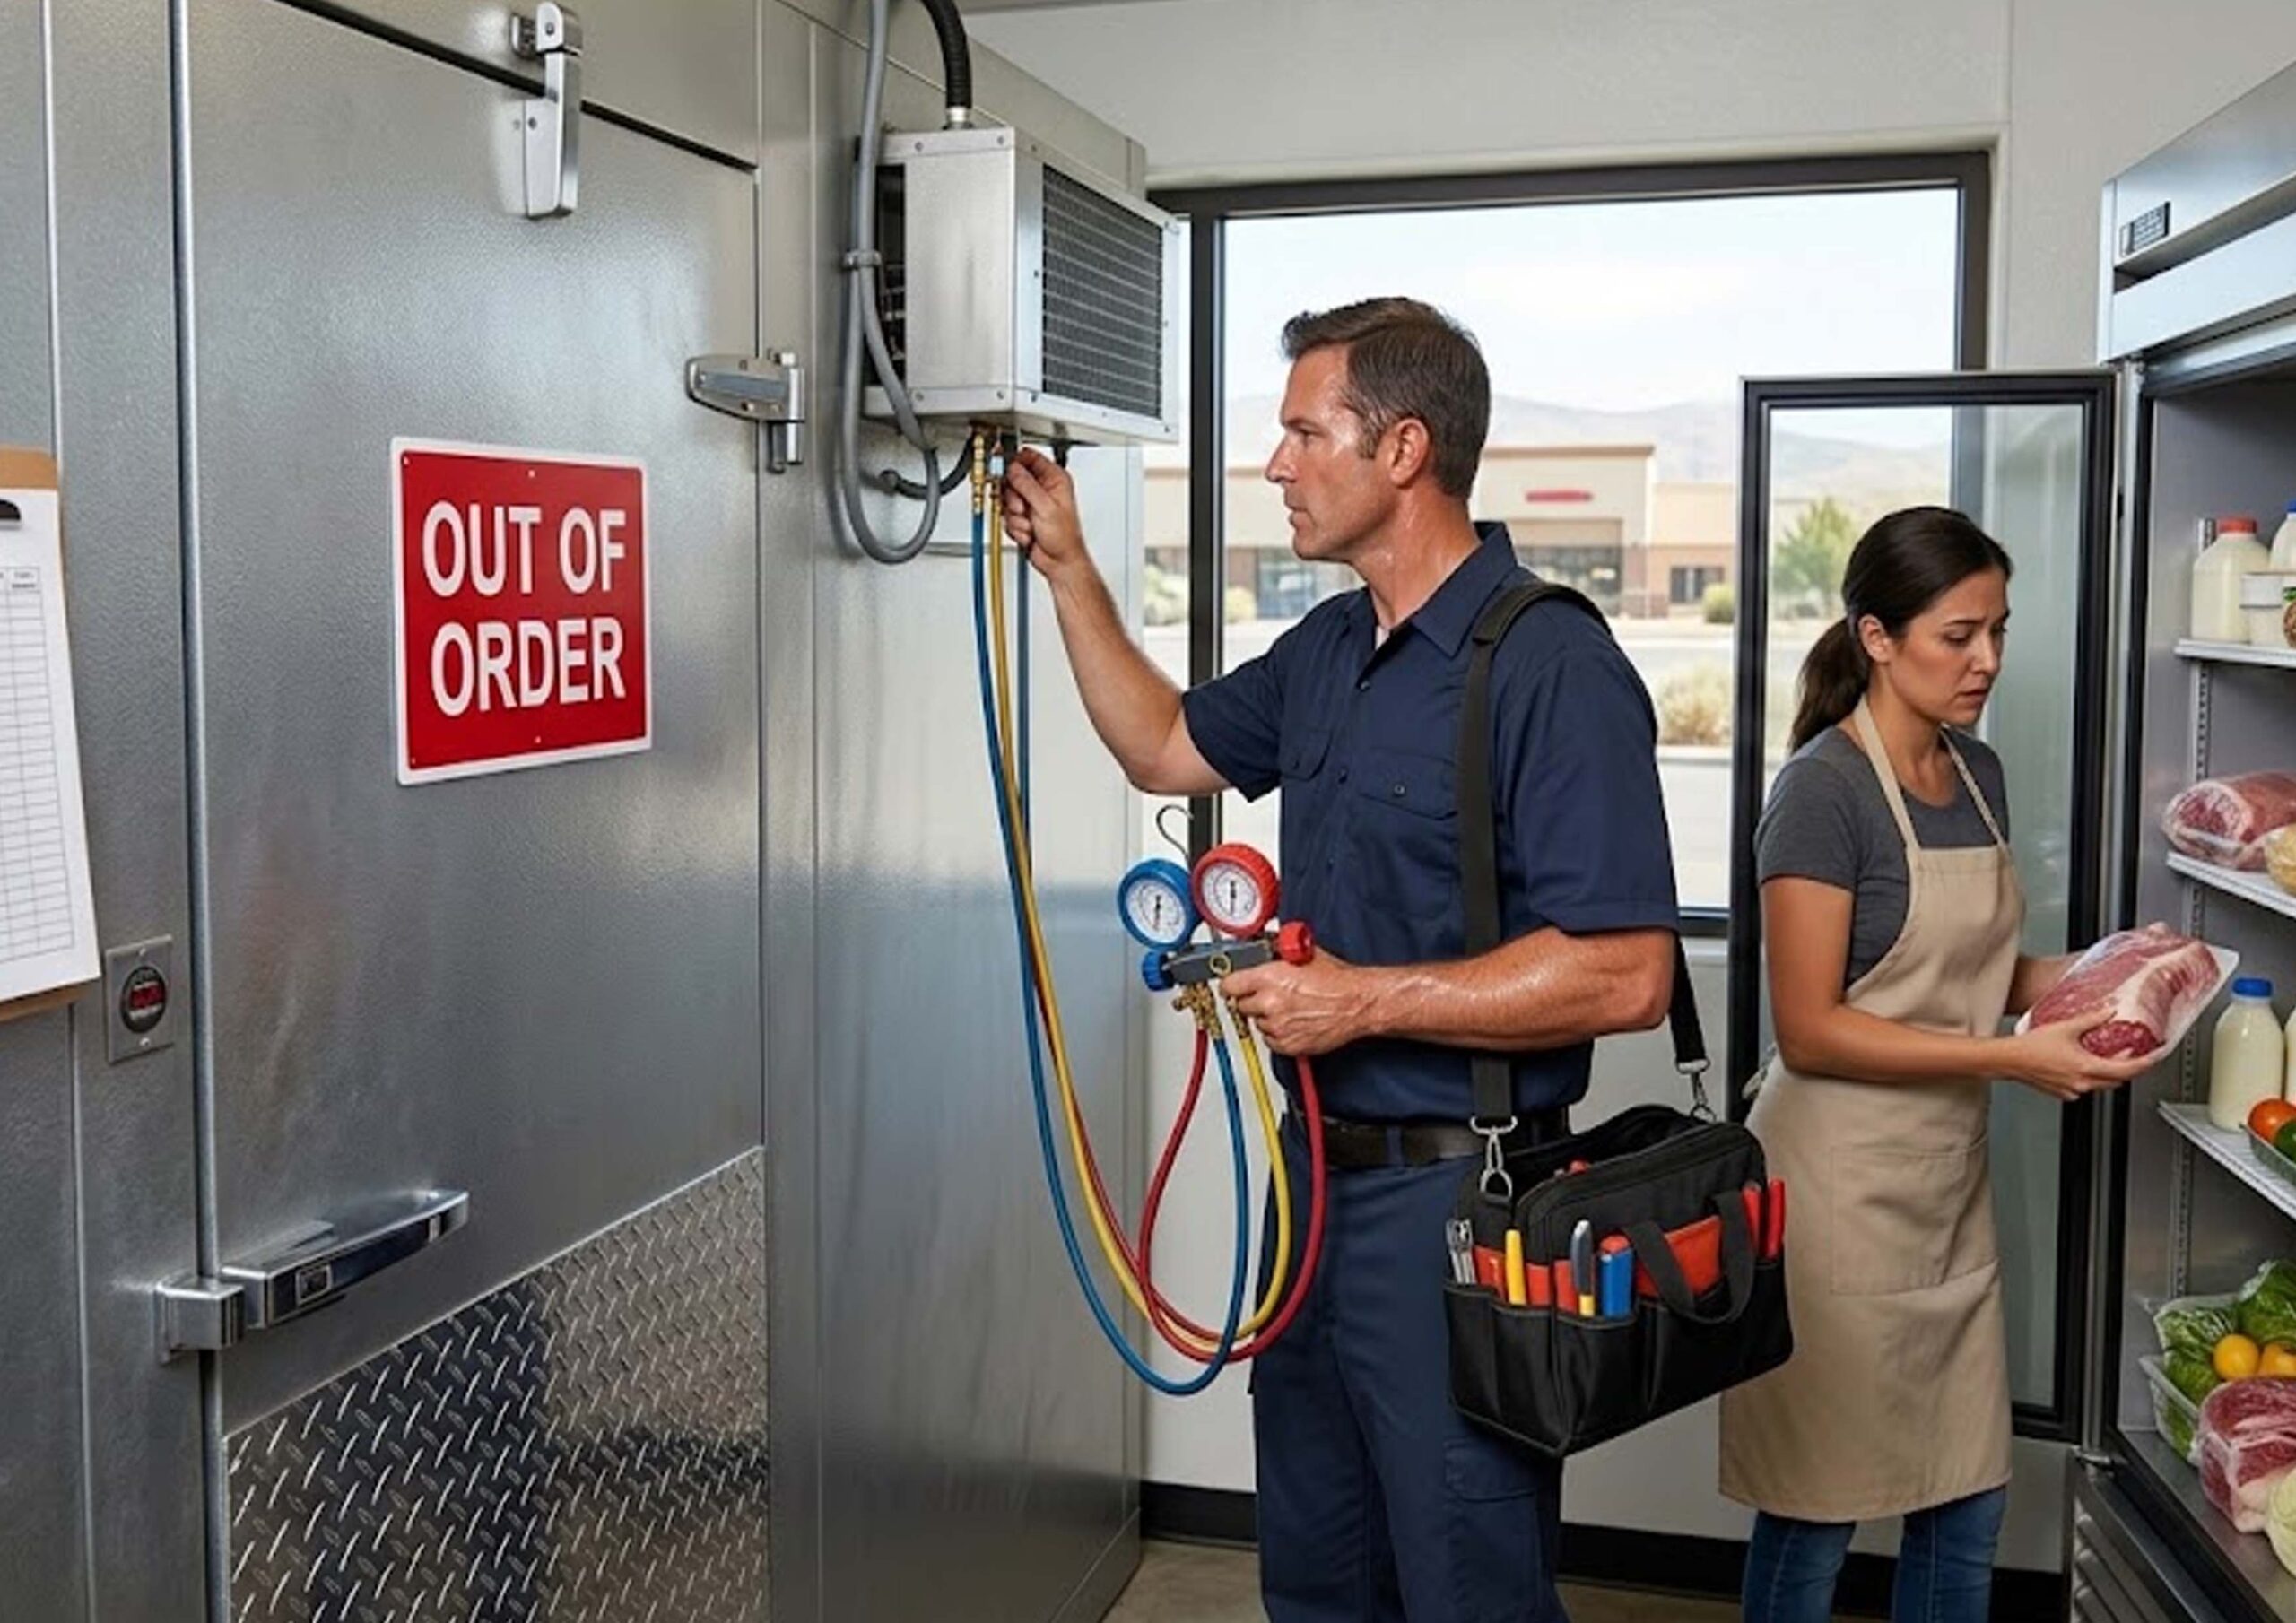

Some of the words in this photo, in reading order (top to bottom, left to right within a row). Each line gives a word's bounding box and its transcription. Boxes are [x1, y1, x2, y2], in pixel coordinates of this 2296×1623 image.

[422, 501, 541, 596] OUT
[560, 507, 626, 594] OF
[431, 617, 626, 716] ORDER
